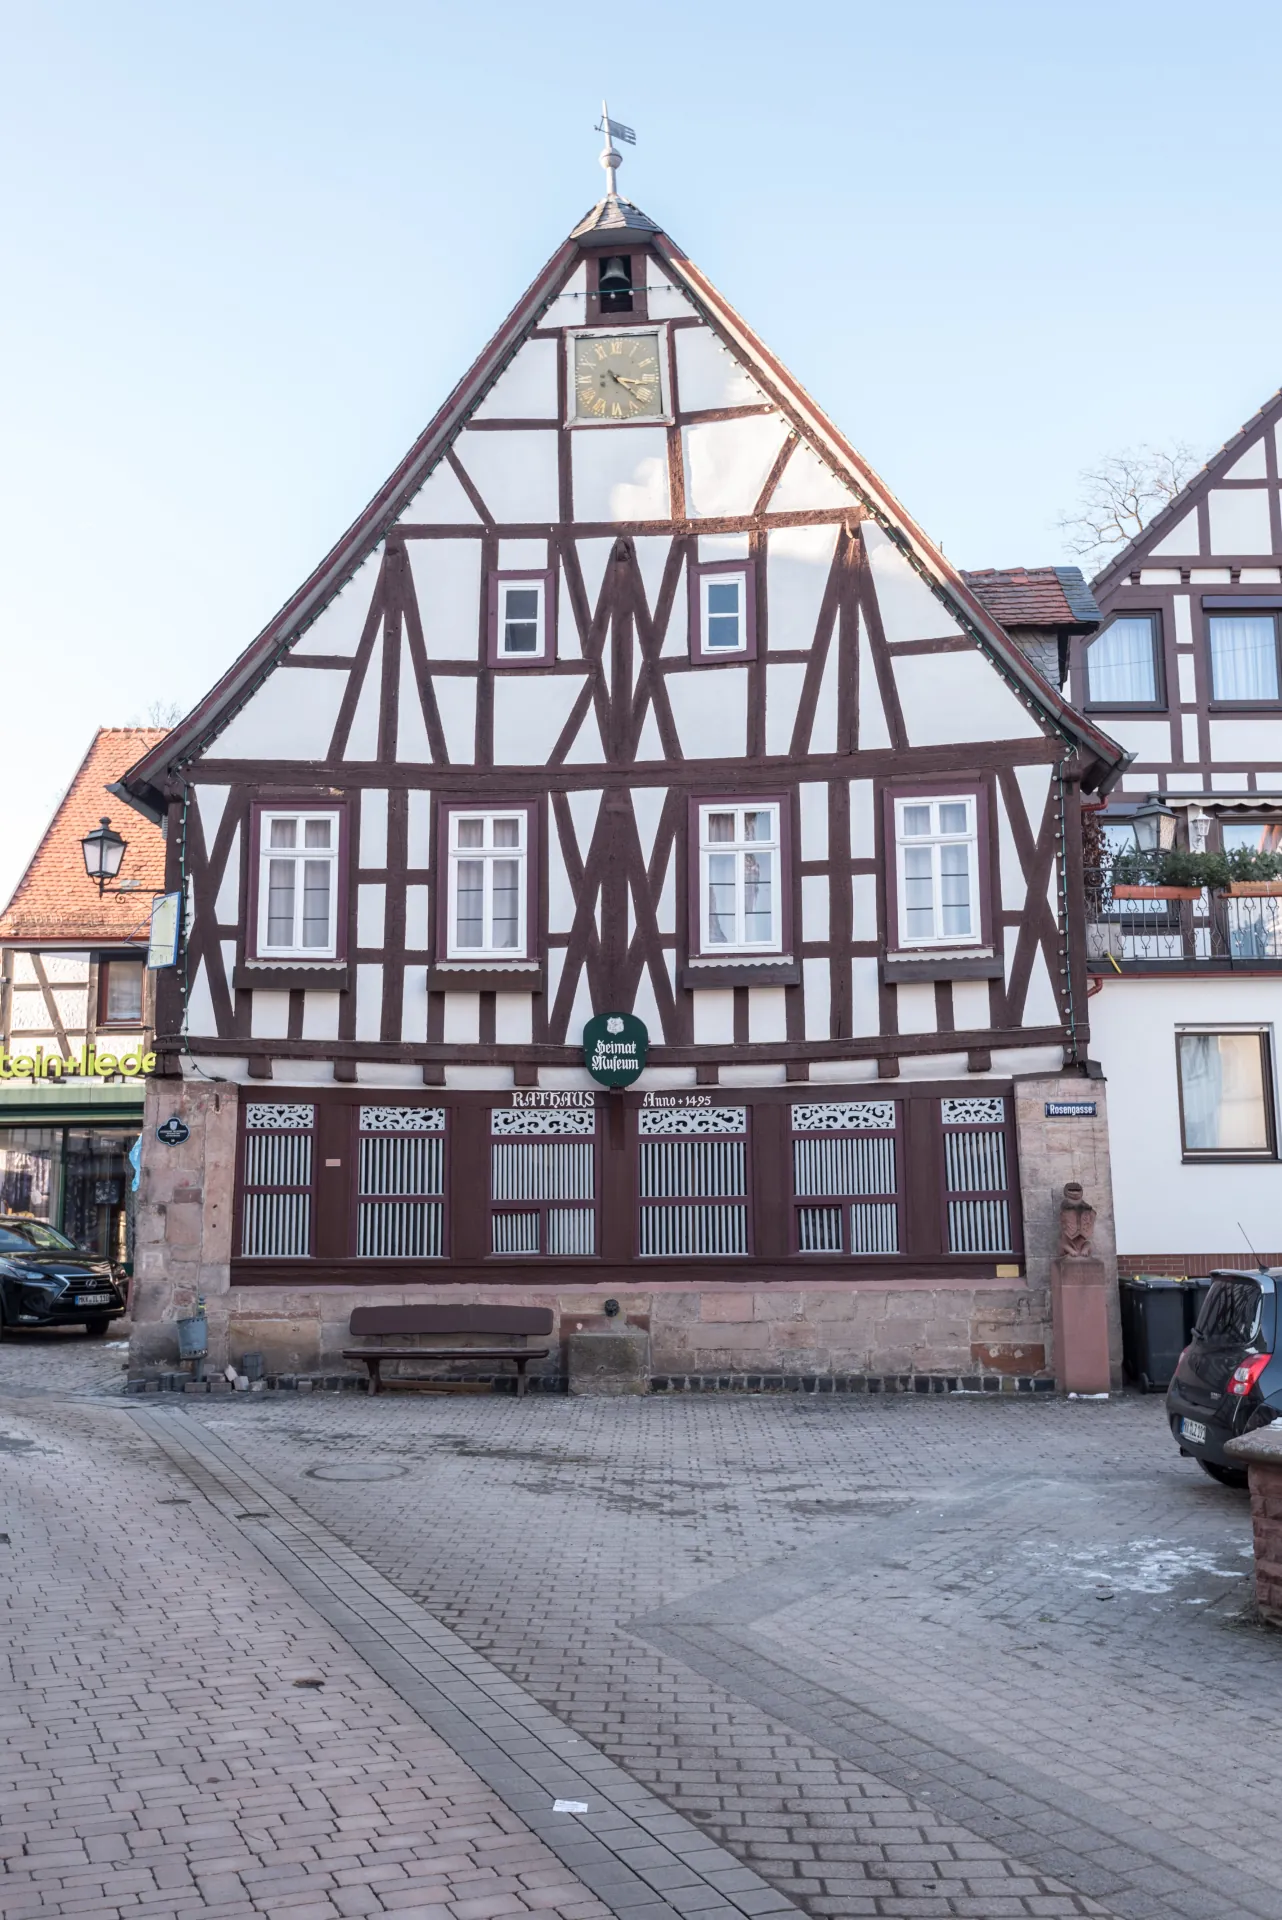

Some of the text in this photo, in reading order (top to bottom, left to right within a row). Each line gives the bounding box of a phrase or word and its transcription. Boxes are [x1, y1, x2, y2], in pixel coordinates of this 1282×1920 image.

[595, 1040, 637, 1056] Heimat
[591, 1055, 640, 1072] Museum
[512, 1091, 595, 1108] RATHAUS
[643, 1092, 676, 1107] Anno
[685, 1095, 712, 1107] 1495
[1050, 1104, 1093, 1116] Rosengasse
